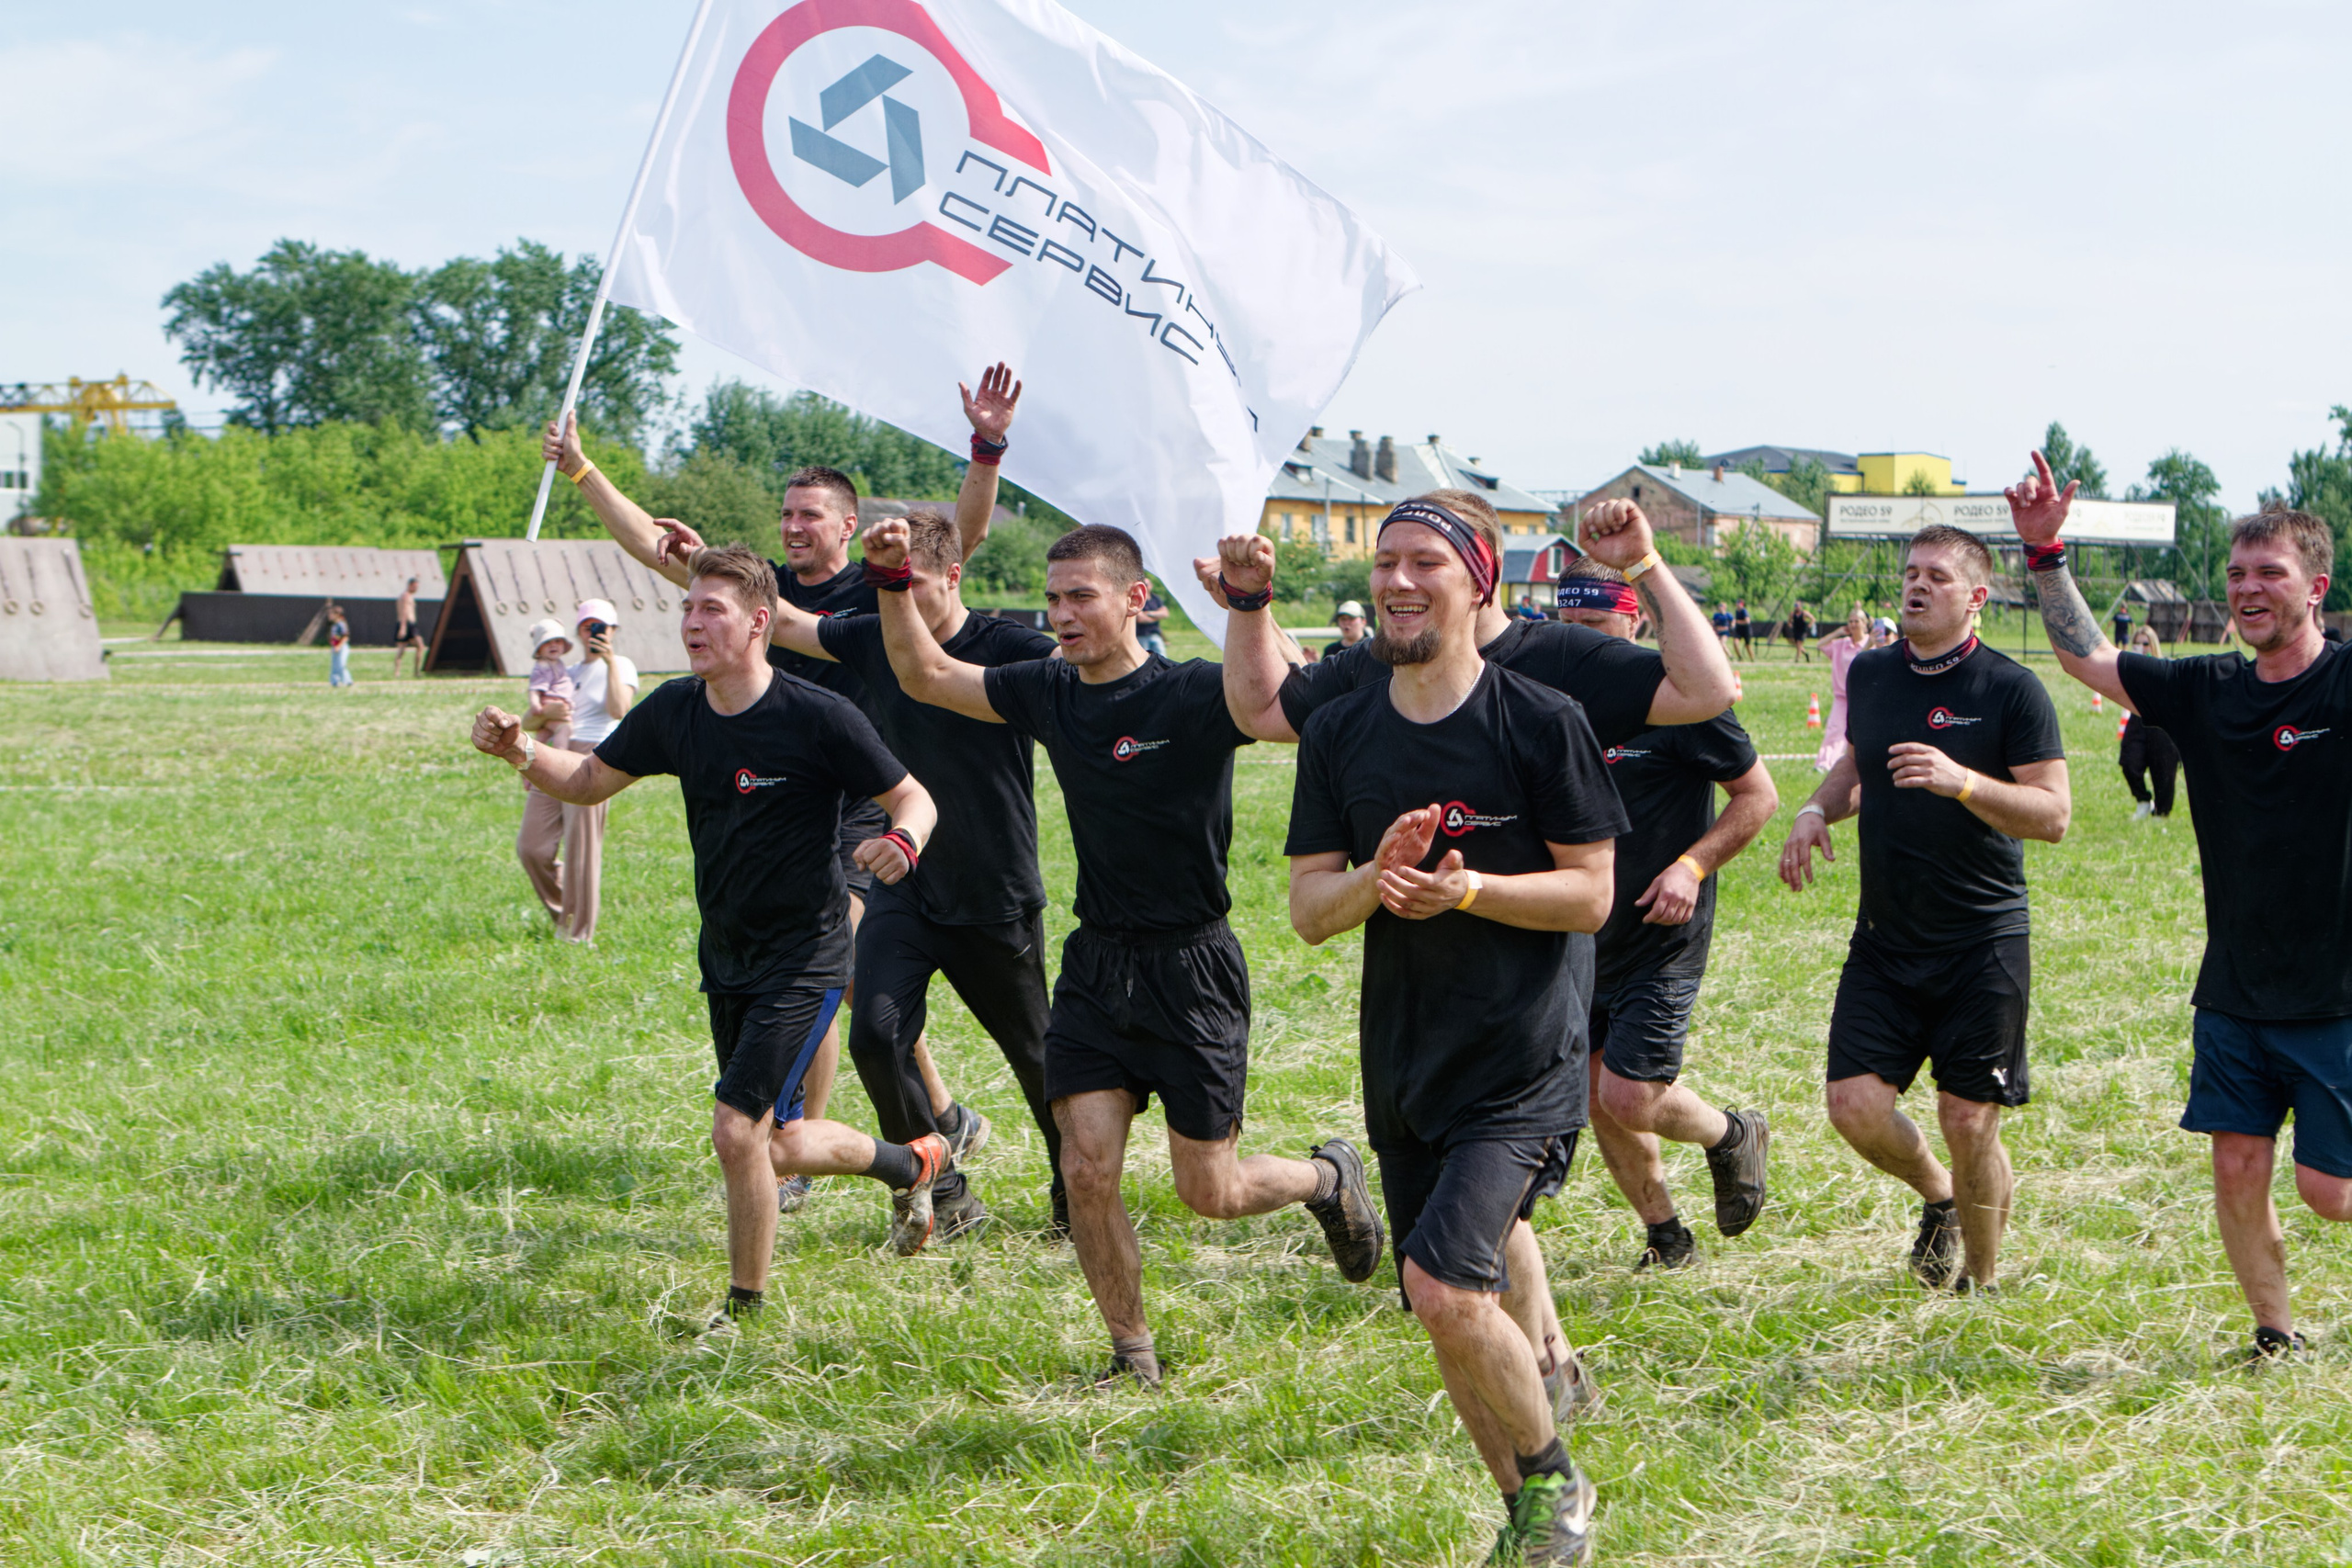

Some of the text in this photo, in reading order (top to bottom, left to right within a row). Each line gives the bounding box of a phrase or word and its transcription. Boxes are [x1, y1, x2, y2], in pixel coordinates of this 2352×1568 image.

[939, 191, 1204, 366] СЕРВИС
[1840, 505, 1893, 517] РОДЕО 59
[1954, 504, 2009, 516] РОДЕО 59
[1583, 588, 1599, 596] 59
